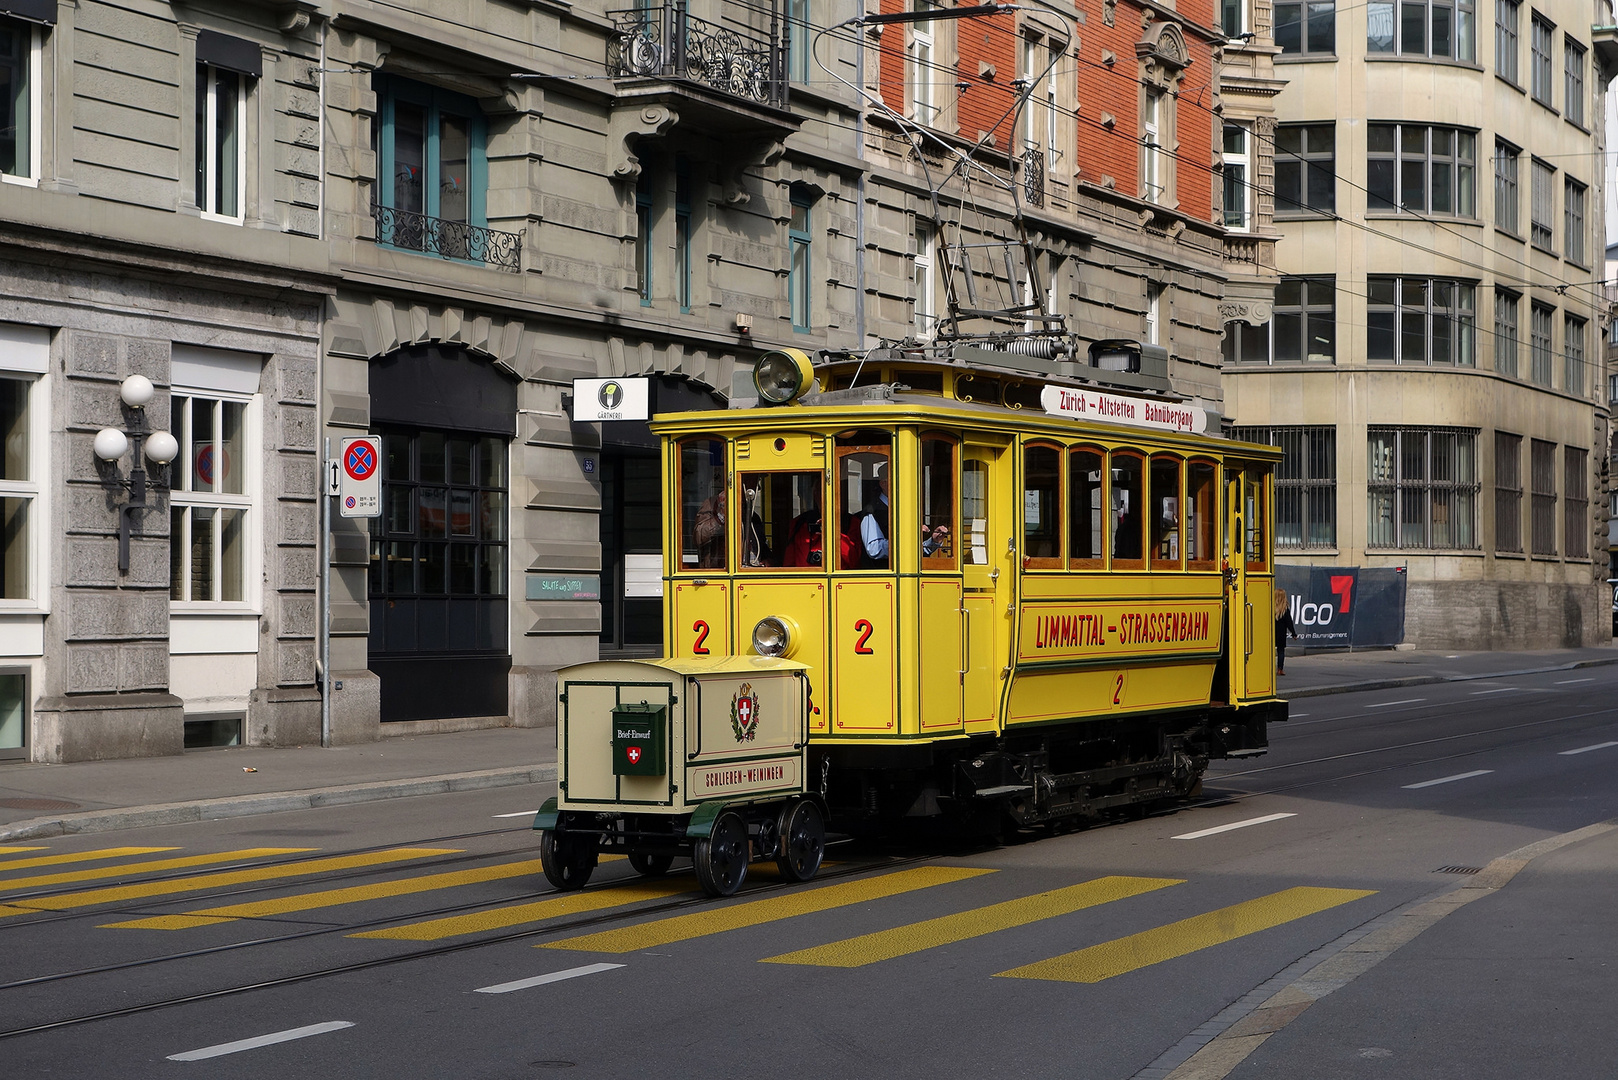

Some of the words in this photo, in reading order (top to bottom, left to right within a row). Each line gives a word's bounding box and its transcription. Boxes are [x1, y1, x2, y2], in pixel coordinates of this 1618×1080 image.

[597, 410, 623, 419] GÄRTNEREI
[1060, 391, 1086, 412] Zürich
[1098, 396, 1135, 419] Altstetten
[1145, 402, 1193, 431] Bahnübergang
[693, 619, 710, 654] 2
[854, 619, 873, 654] 2
[1113, 674, 1123, 704] 2
[617, 729, 651, 739] Brief-Einwurf
[705, 766, 783, 788] SCHLIEREN-WEININGEN
